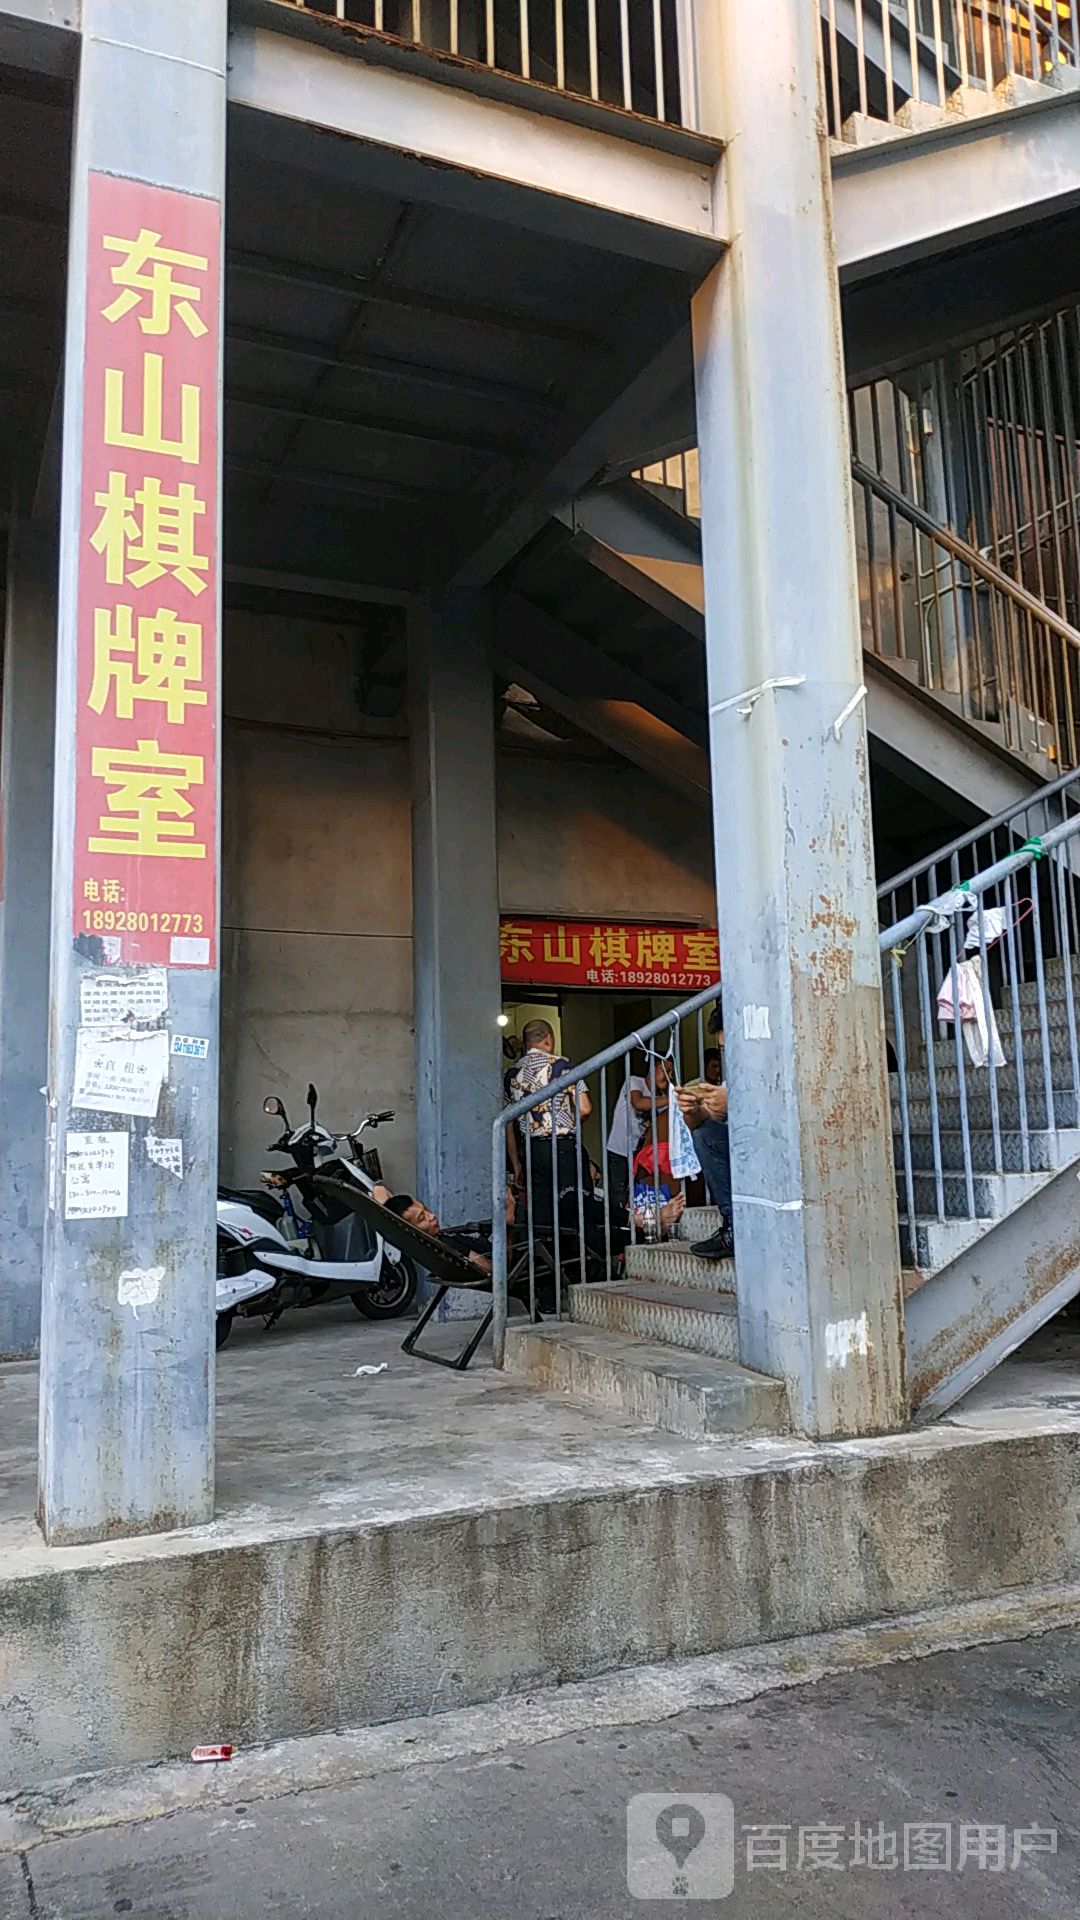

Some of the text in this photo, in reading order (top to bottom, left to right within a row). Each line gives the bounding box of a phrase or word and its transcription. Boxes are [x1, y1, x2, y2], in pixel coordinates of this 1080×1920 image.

[87, 228, 211, 859] 东山棋牌室
[82, 909, 205, 933] 18928012773
[500, 923, 719, 971] 东山棋牌室
